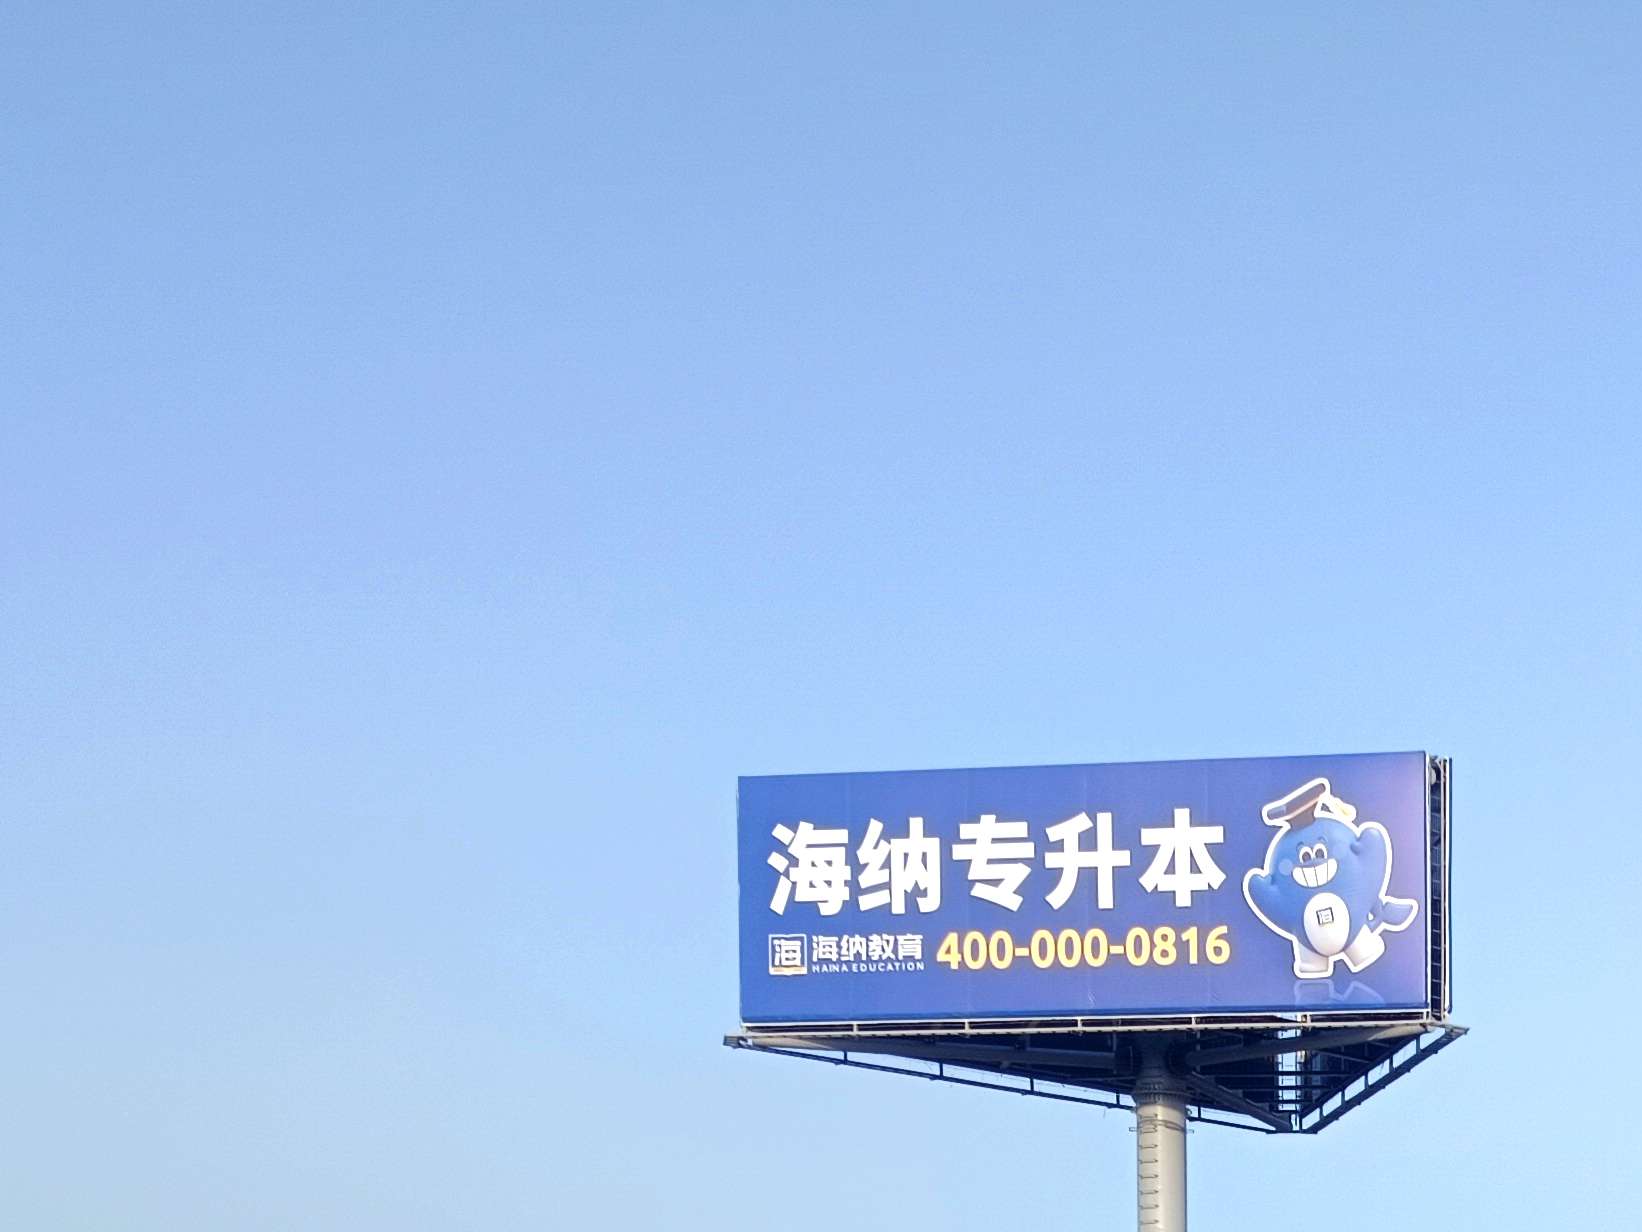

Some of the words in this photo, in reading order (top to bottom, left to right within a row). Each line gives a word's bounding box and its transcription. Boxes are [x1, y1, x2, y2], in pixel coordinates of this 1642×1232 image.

[767, 807, 1227, 916] 海纳专升本
[812, 933, 924, 962] 海纳教育
[936, 925, 1231, 970] 400-000-0816
[812, 962, 849, 973] HAINA
[852, 961, 925, 973] EDUCATION
